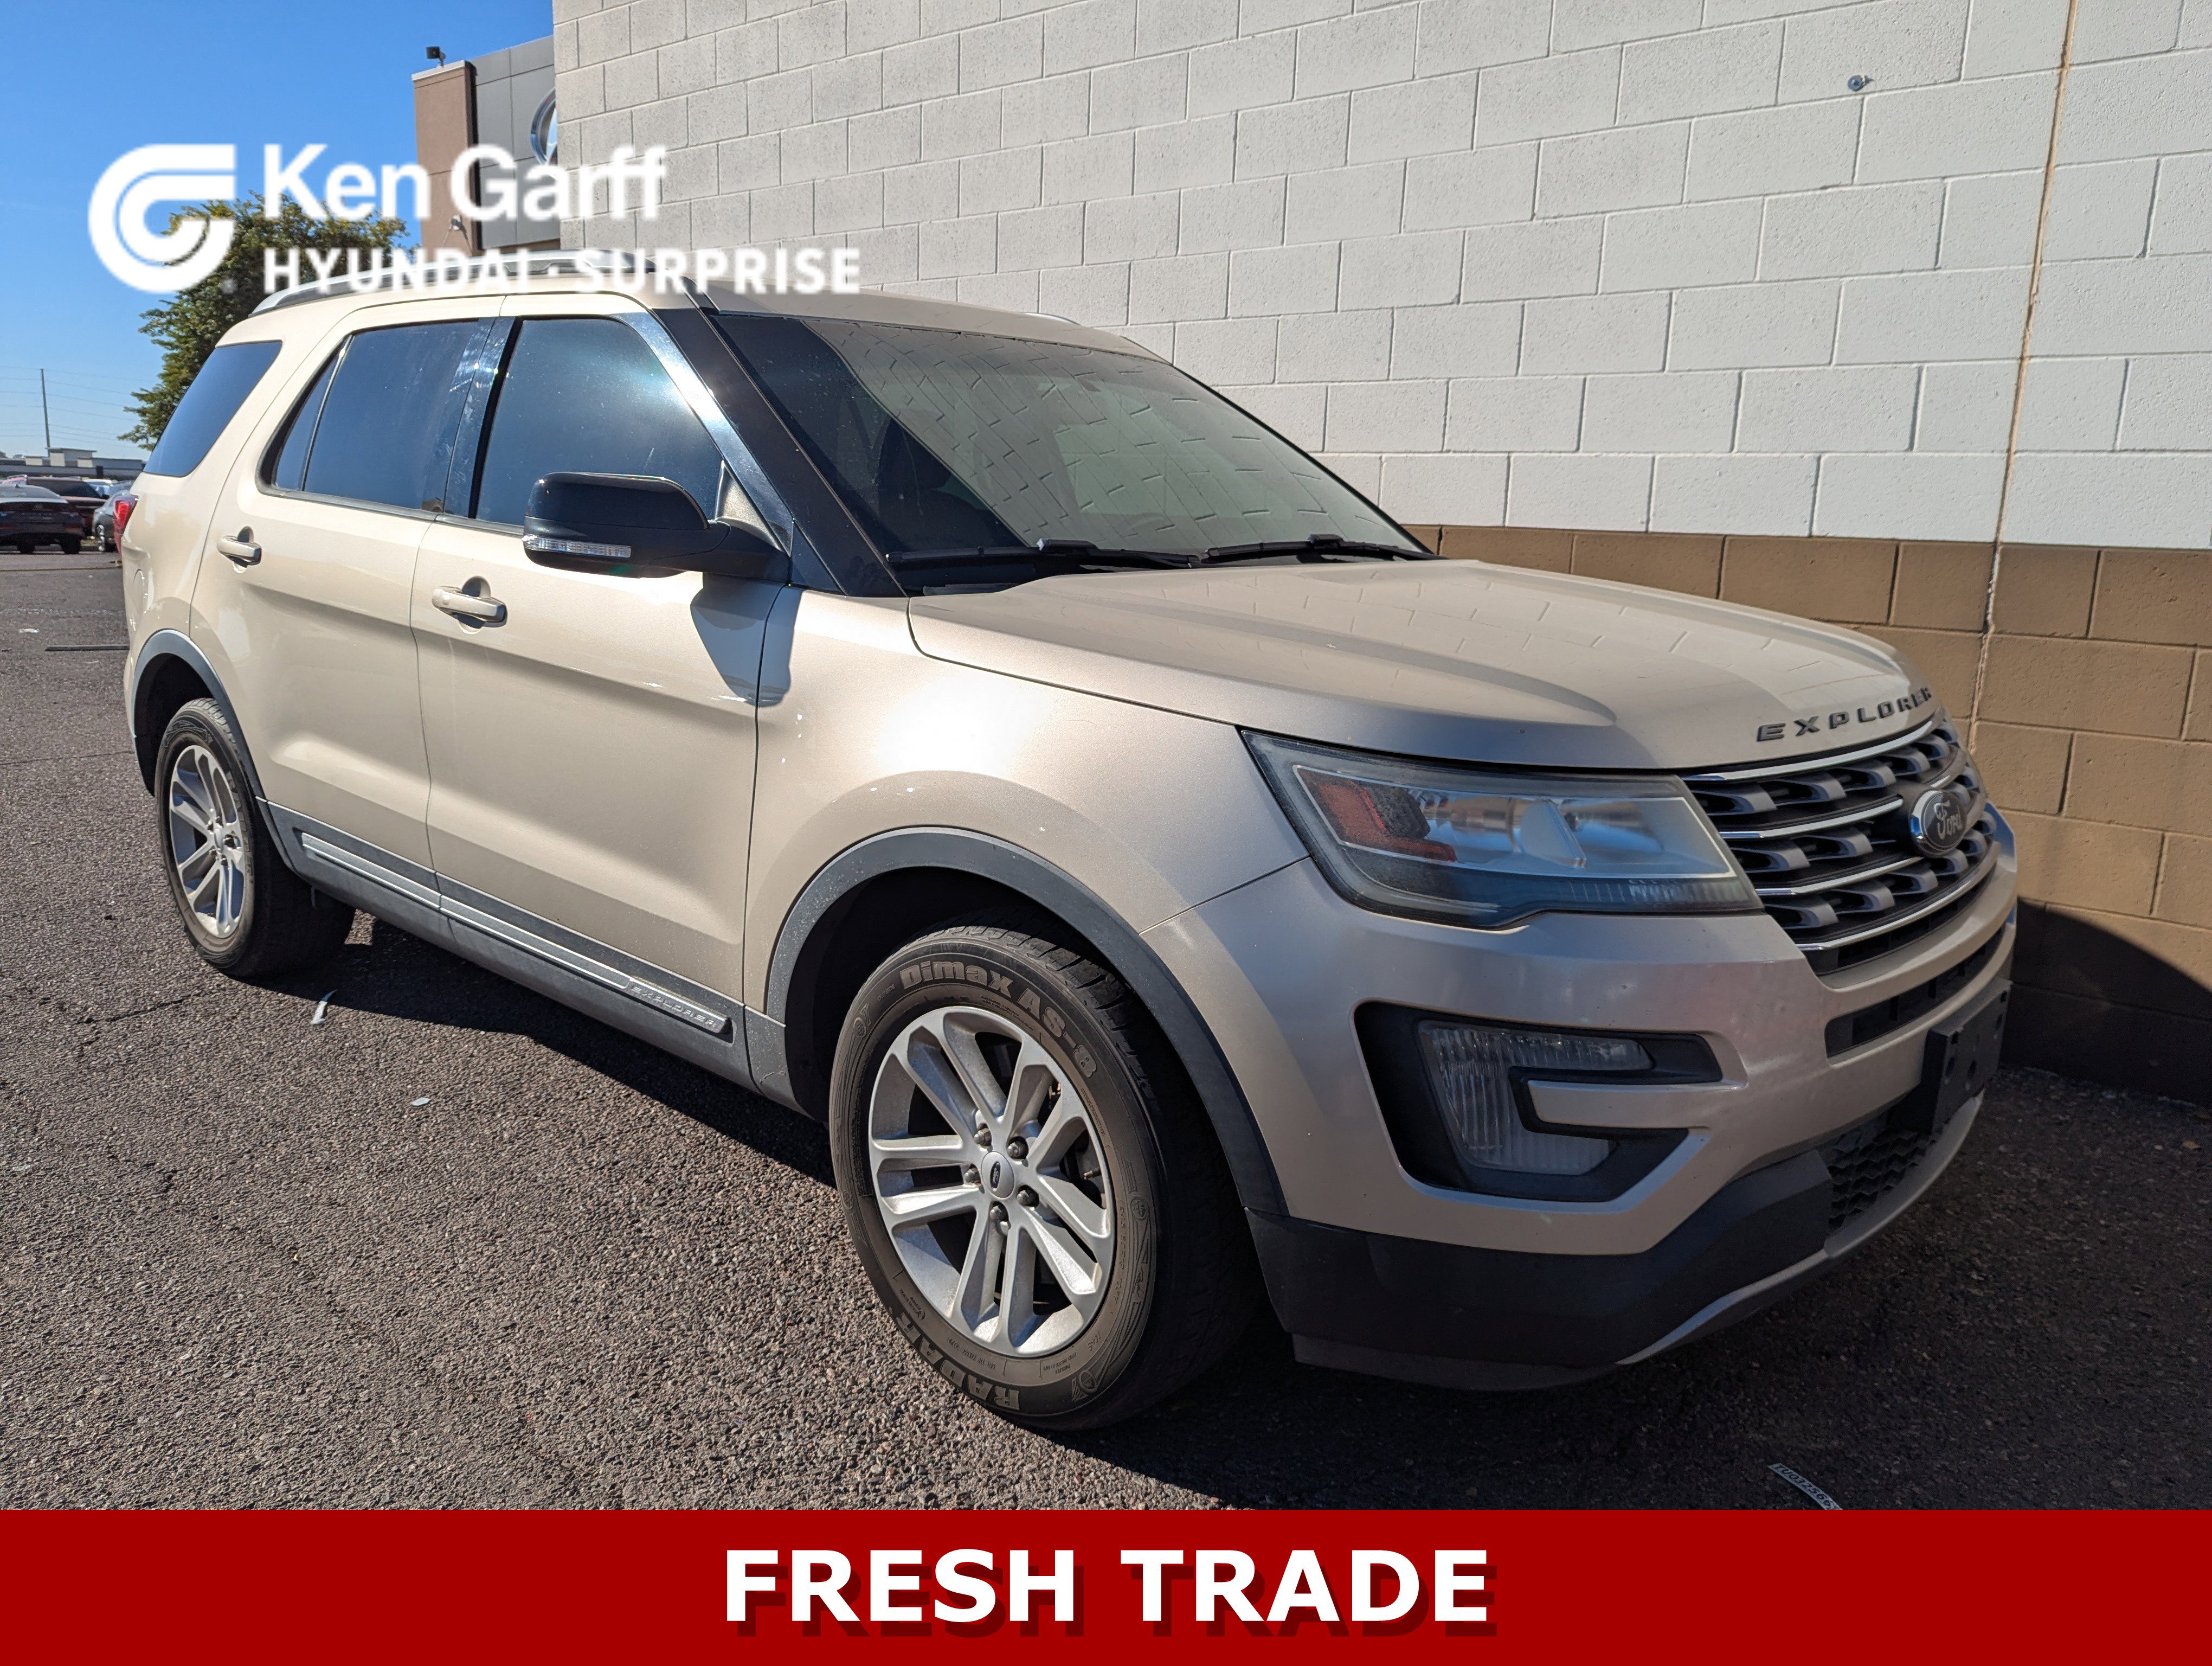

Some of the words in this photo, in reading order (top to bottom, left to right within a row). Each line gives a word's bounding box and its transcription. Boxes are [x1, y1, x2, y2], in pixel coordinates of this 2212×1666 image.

[1757, 687, 1932, 742] EXPLORER
[1934, 800, 1963, 841] Ford
[631, 985, 716, 1028] EXPLORER
[900, 960, 1013, 999] Dimax
[1017, 988, 1097, 1078] AS-8
[896, 1311, 1020, 1411] RADAR
